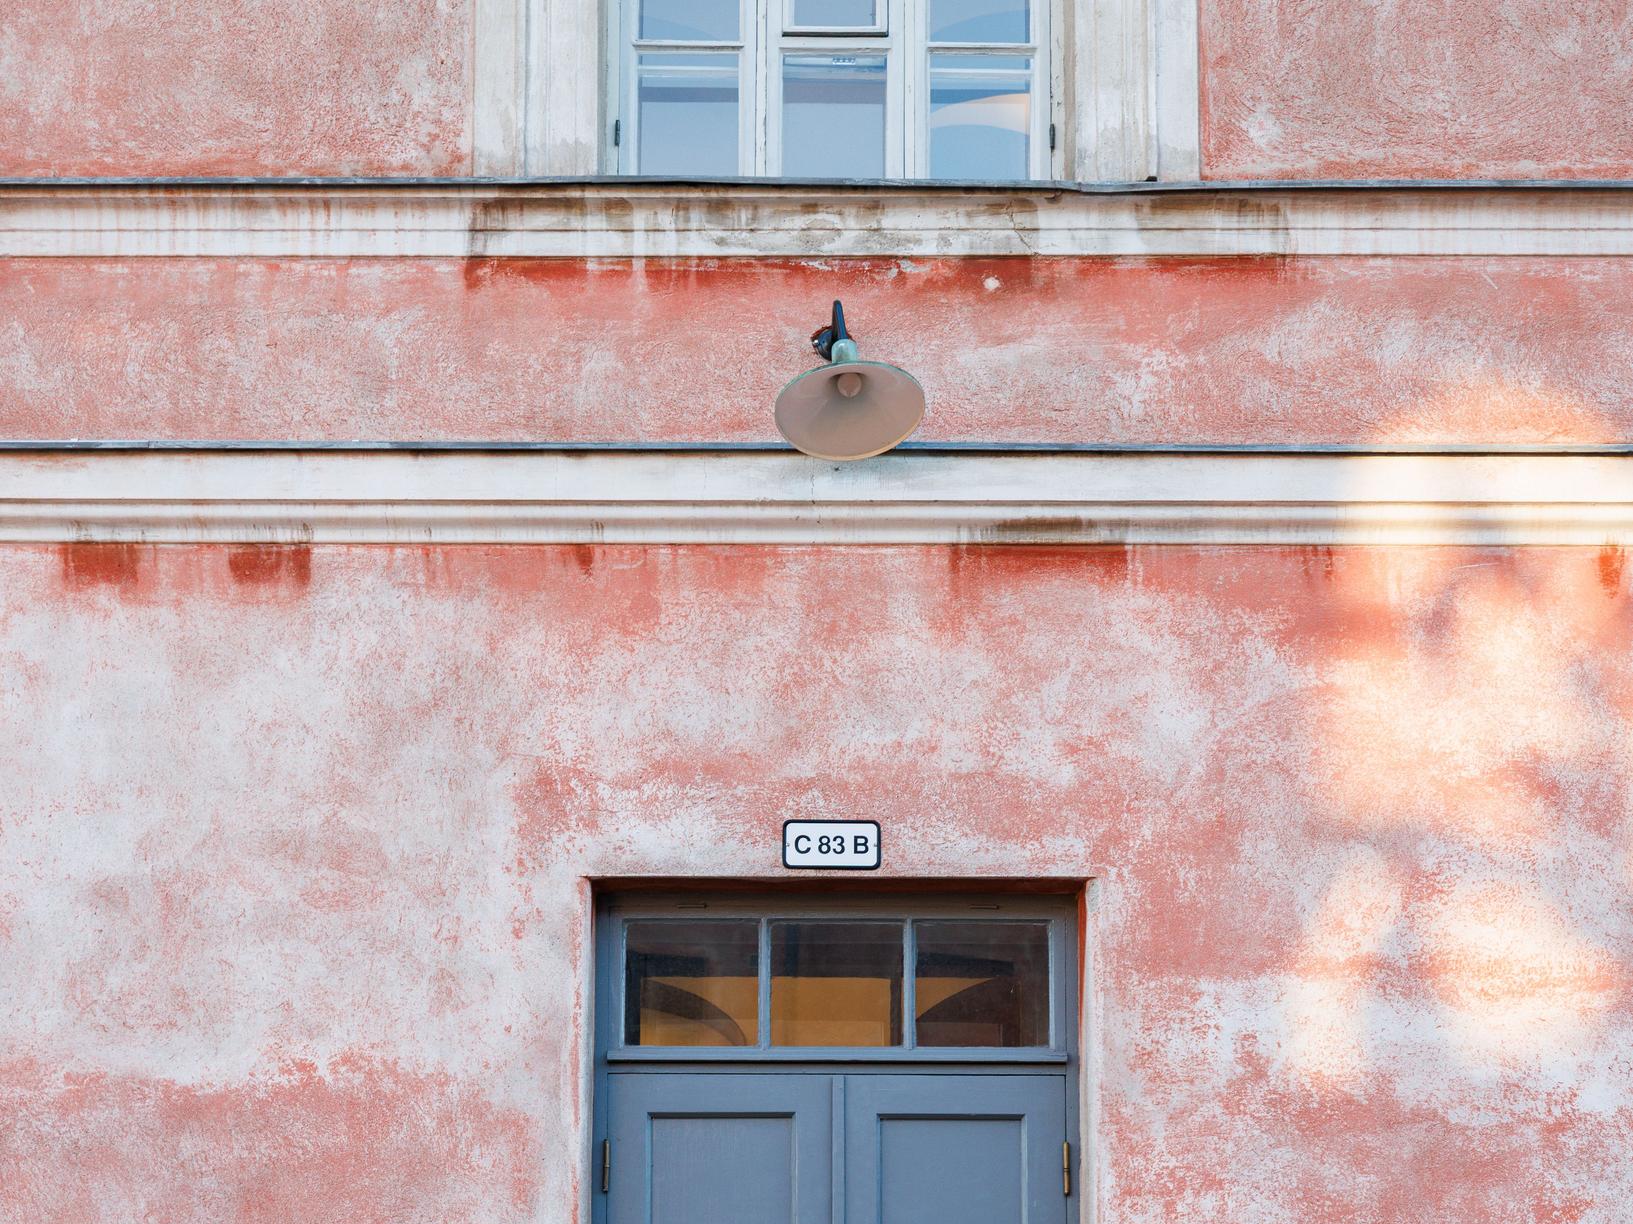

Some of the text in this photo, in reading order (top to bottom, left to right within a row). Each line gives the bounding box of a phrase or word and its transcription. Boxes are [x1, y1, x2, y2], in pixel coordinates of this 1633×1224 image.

[794, 834, 869, 855] C 83 B
